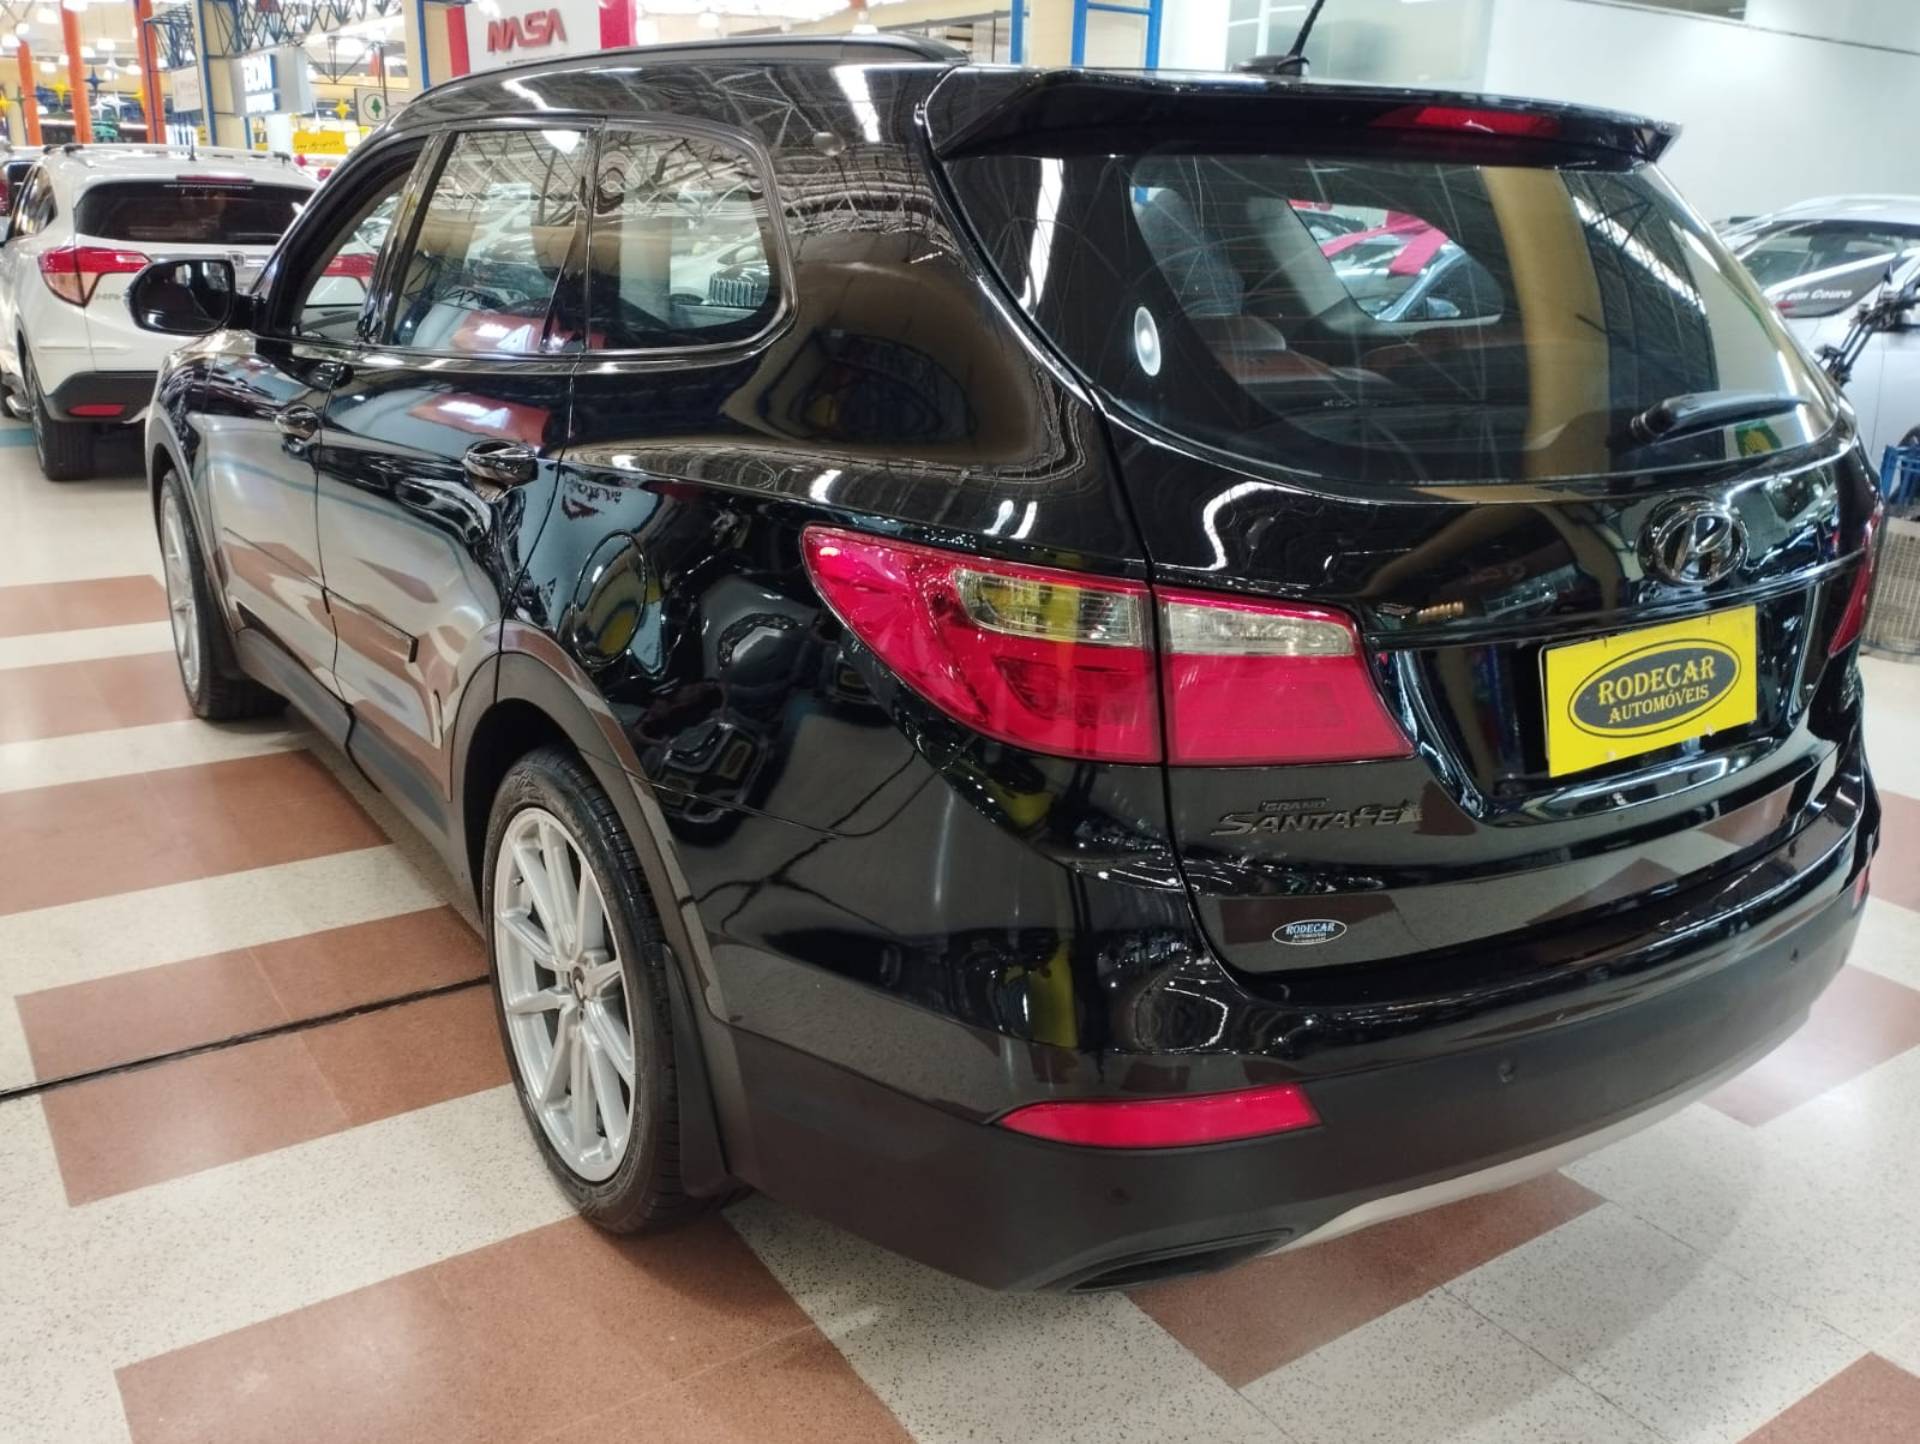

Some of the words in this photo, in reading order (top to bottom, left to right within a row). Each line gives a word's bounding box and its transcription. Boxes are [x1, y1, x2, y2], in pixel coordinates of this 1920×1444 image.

[487, 8, 568, 52] NASA
[1598, 655, 1716, 706] RODECAR
[1608, 684, 1710, 724] AUTOMÓVEIS
[1286, 922, 1336, 935] RODECAR
